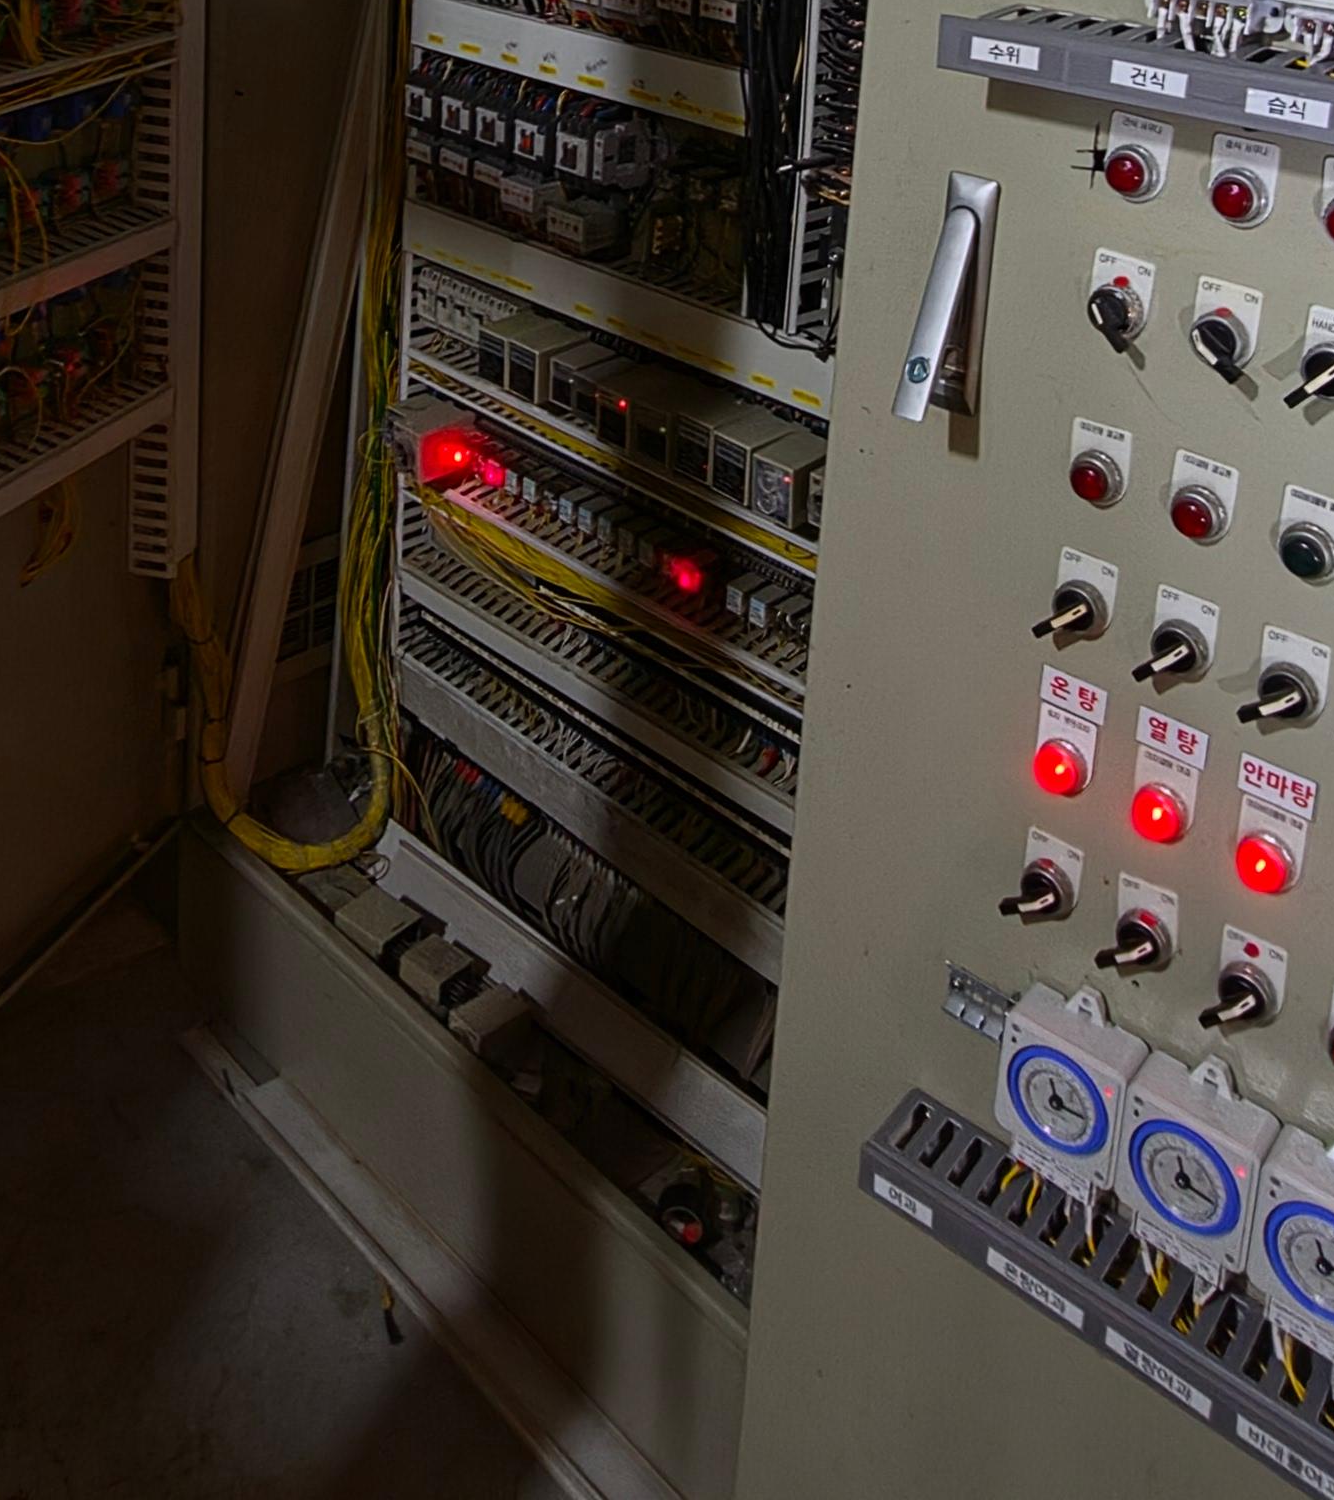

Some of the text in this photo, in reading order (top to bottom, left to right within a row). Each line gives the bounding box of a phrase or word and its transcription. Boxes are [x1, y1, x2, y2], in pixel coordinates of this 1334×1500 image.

[988, 43, 1021, 65] 수위
[1130, 67, 1167, 90] 건식
[1267, 96, 1307, 121] 습식
[1098, 254, 1152, 278] OFF ON
[1202, 280, 1259, 305] OFF ON
[1243, 761, 1314, 809] 안마탕
